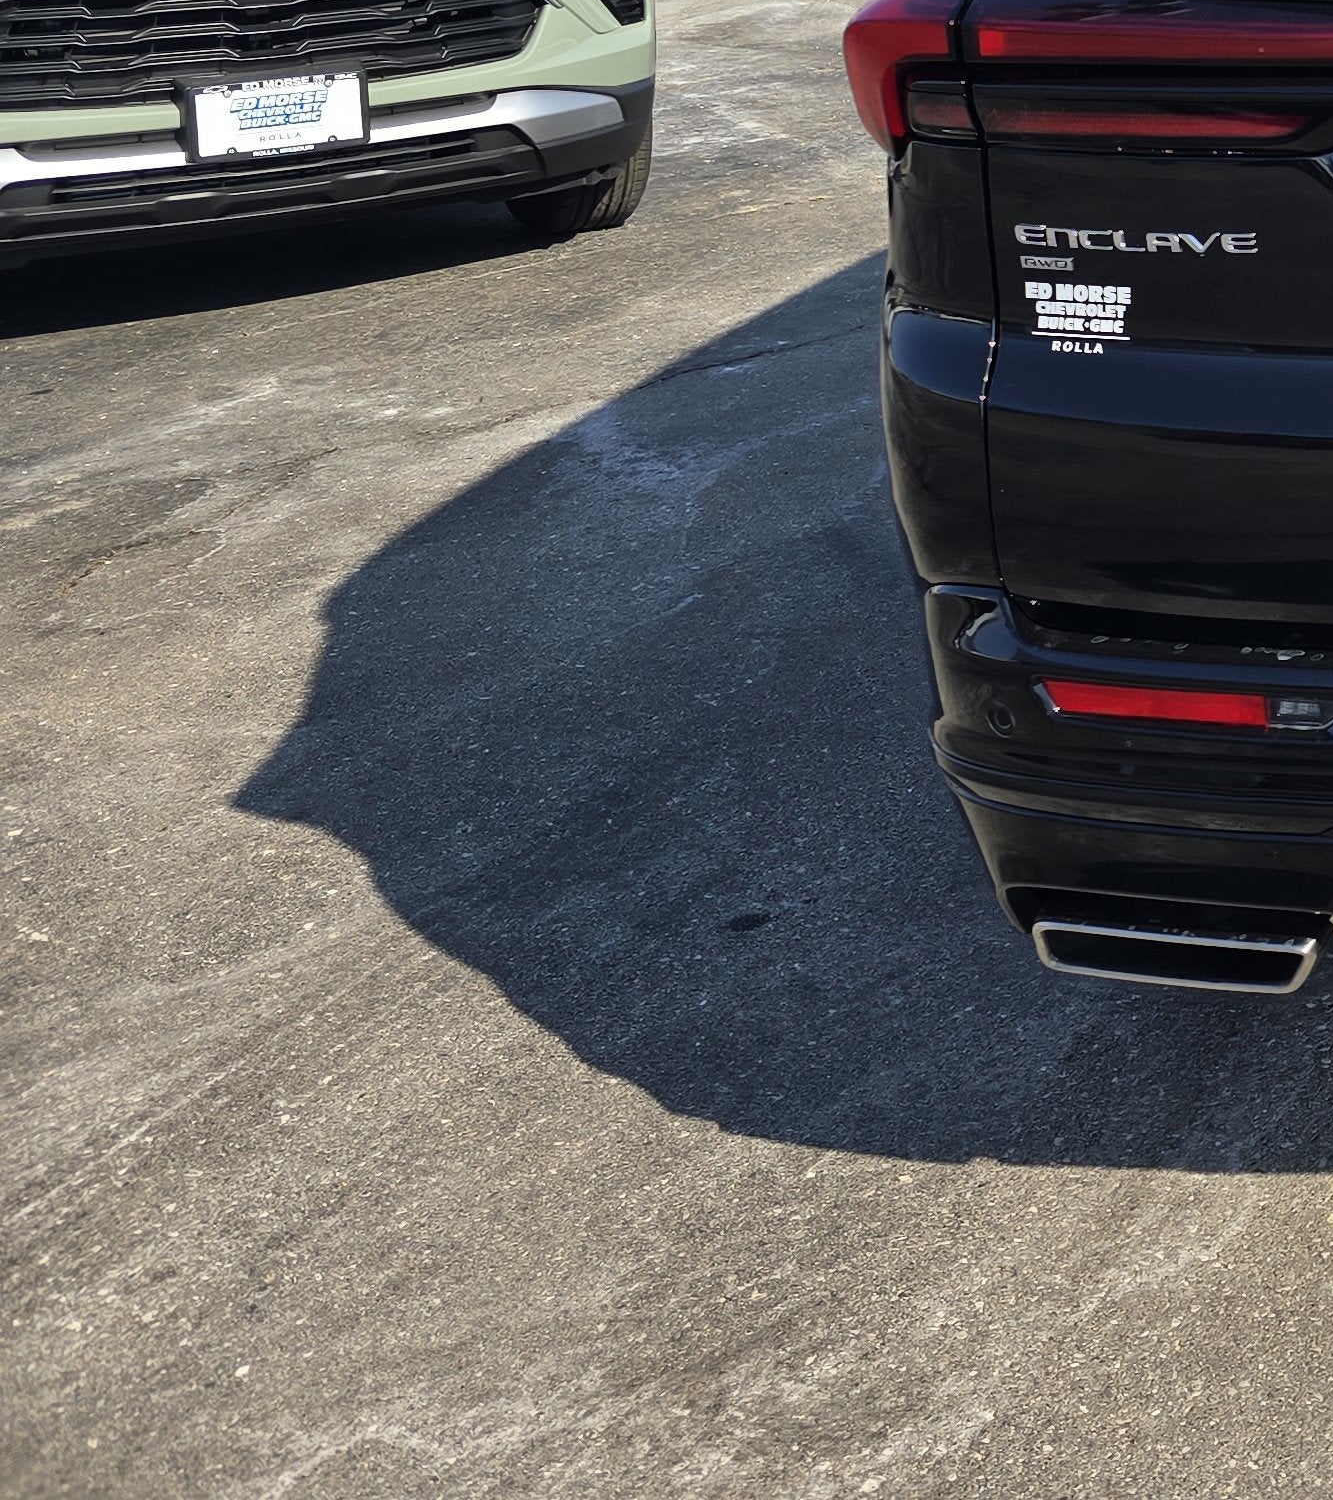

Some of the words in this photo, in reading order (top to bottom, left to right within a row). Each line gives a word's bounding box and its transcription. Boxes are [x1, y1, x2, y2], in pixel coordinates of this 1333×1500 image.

[242, 81, 260, 92] ED
[262, 76, 311, 90] MORSE
[230, 97, 258, 113] ED
[258, 89, 328, 108] MORSE
[238, 102, 323, 120] CHEVROLET
[259, 132, 302, 143] ROLLA
[1014, 223, 1259, 254] ENCLAVE
[1025, 281, 1053, 300] ED
[1055, 284, 1132, 305] MORSE
[1035, 300, 1127, 319] CHEVROLET
[1051, 340, 1104, 355] ROLLA
